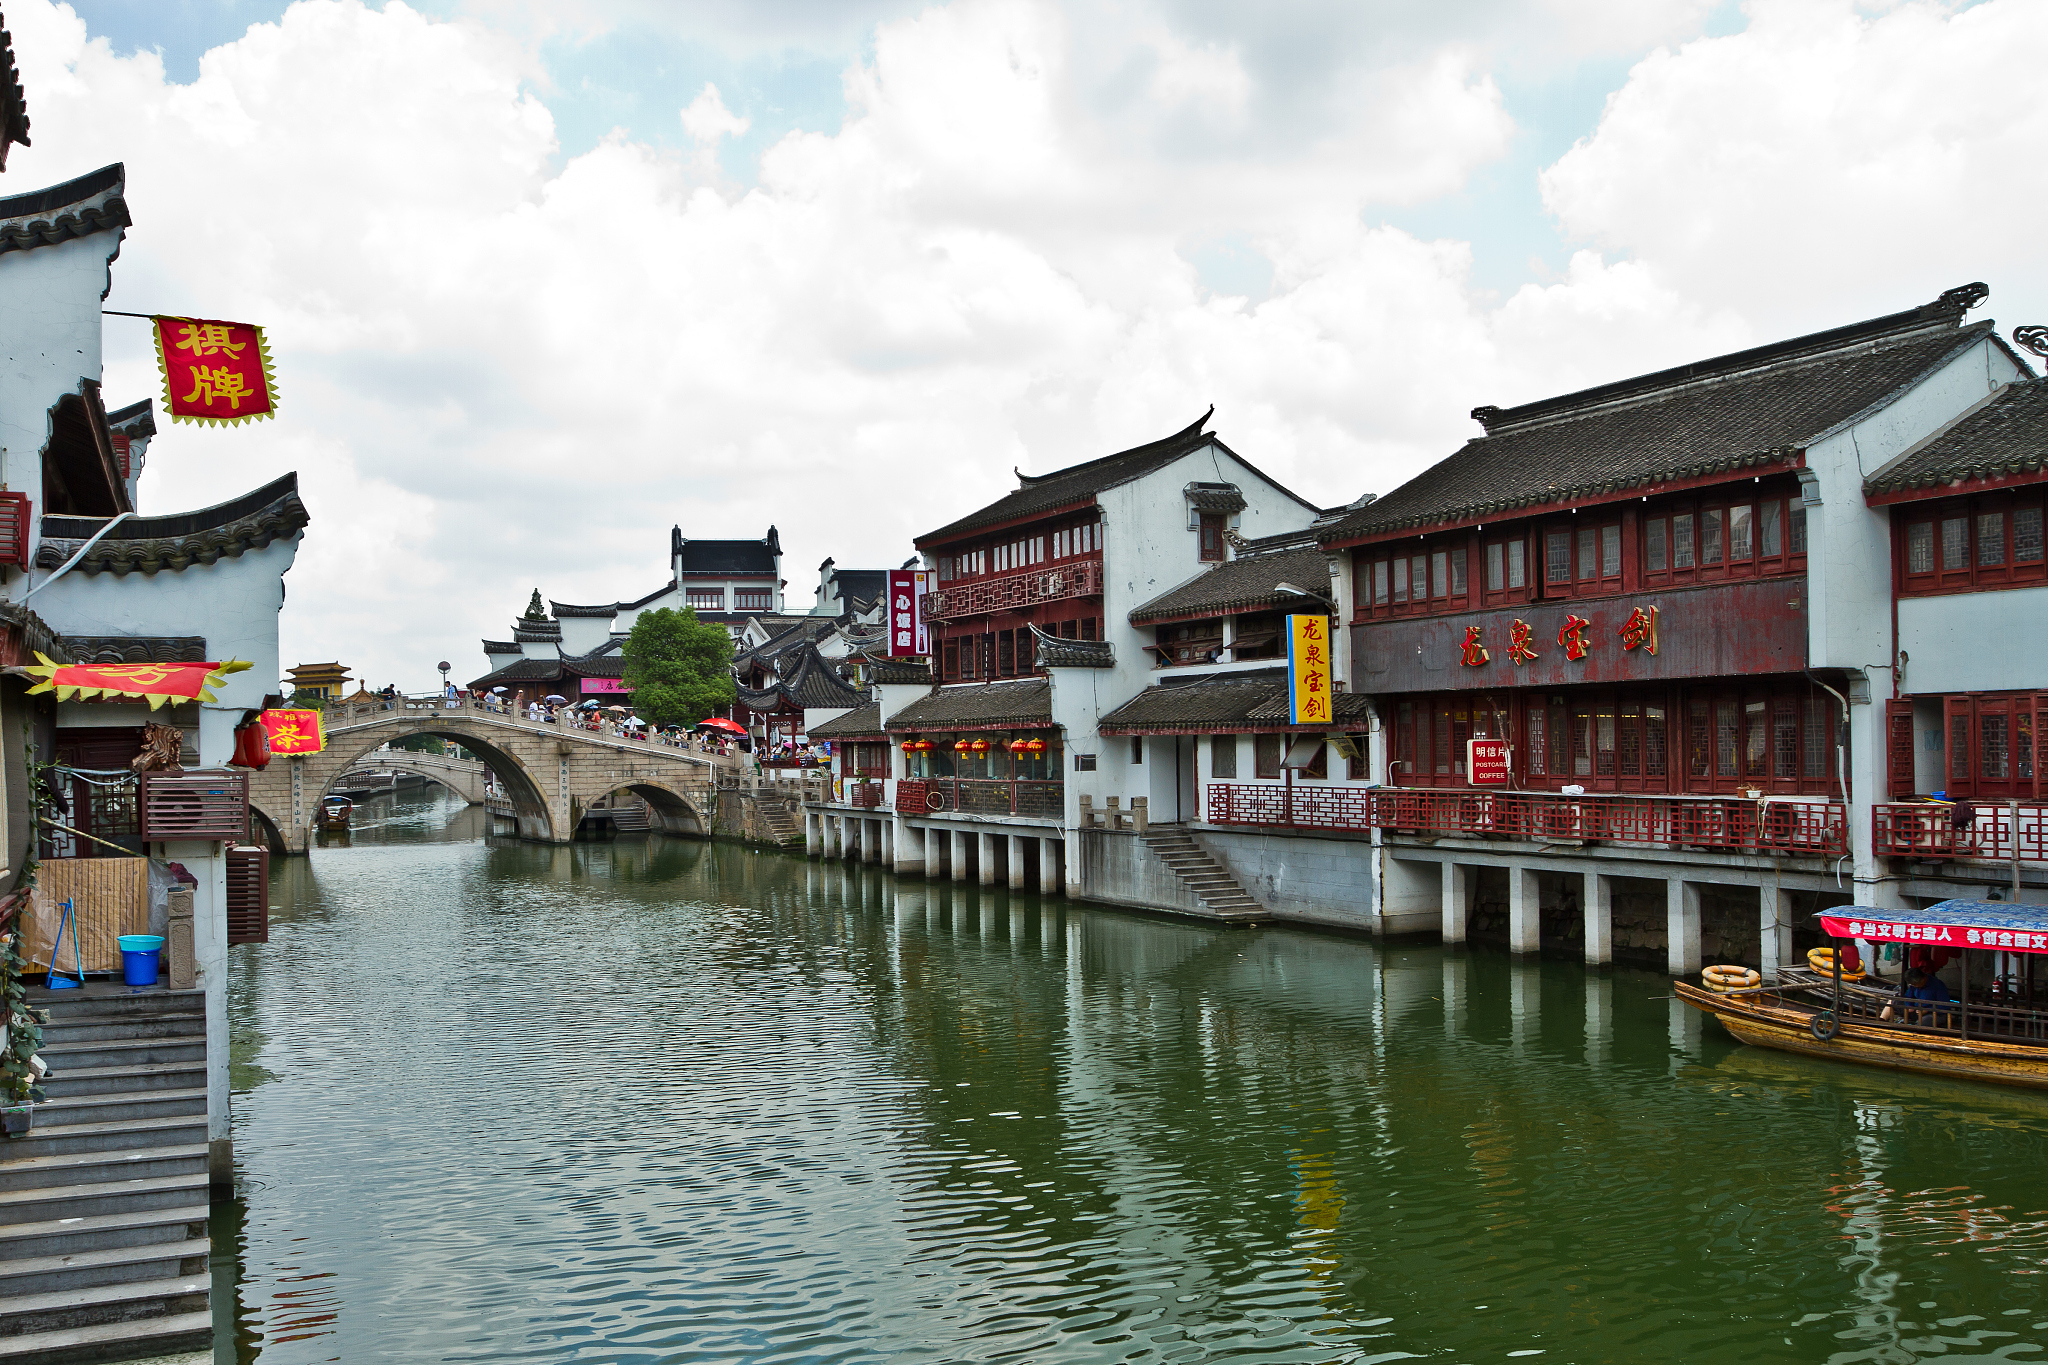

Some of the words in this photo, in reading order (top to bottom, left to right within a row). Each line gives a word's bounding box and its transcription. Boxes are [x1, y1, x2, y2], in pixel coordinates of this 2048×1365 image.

[176, 324, 254, 409] 棋牌
[895, 581, 911, 647] 一心饭店
[1460, 605, 1659, 667] 龙泉宝剑
[1302, 618, 1325, 719] 龙泉宝剑
[269, 723, 313, 750] 茶
[1475, 746, 1506, 758] 明信片
[1848, 921, 1953, 942] 争当文明七宝人
[1966, 929, 2047, 949] 争创全国文
